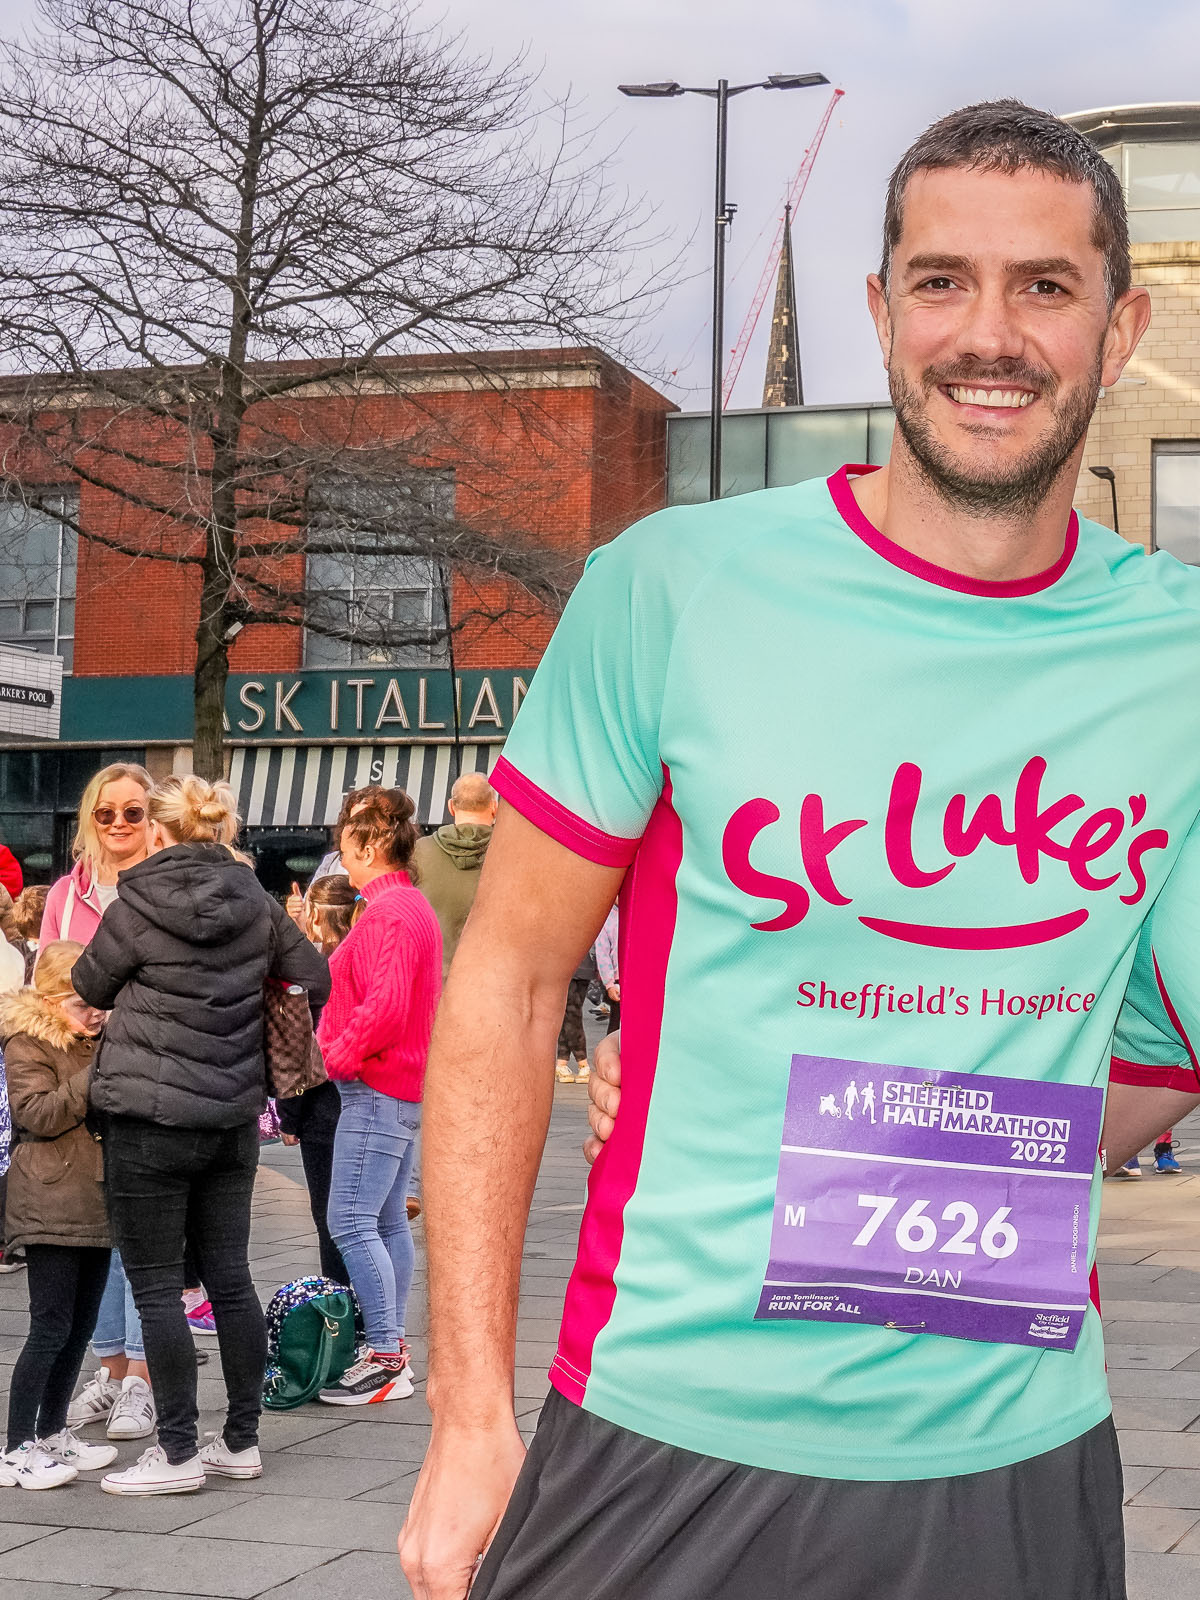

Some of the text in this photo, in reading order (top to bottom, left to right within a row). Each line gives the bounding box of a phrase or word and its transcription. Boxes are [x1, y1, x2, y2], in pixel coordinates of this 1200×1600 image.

[0, 686, 47, 703] RKER'S POOL
[722, 756, 1169, 932] St Luke's
[797, 981, 1096, 1020] Sheffield's Hospice
[885, 1083, 989, 1111] SHEFFIELD
[883, 1104, 1068, 1140] HALF MARATHON
[1010, 1140, 1067, 1164] 2022
[783, 1205, 807, 1227] M
[852, 1193, 1019, 1260] 7626
[903, 1267, 963, 1289] DAN
[768, 1301, 861, 1315] RUN FOR ALL
[1035, 1313, 1070, 1323] Sheffield
[355, 1374, 388, 1392] NAUTICA
